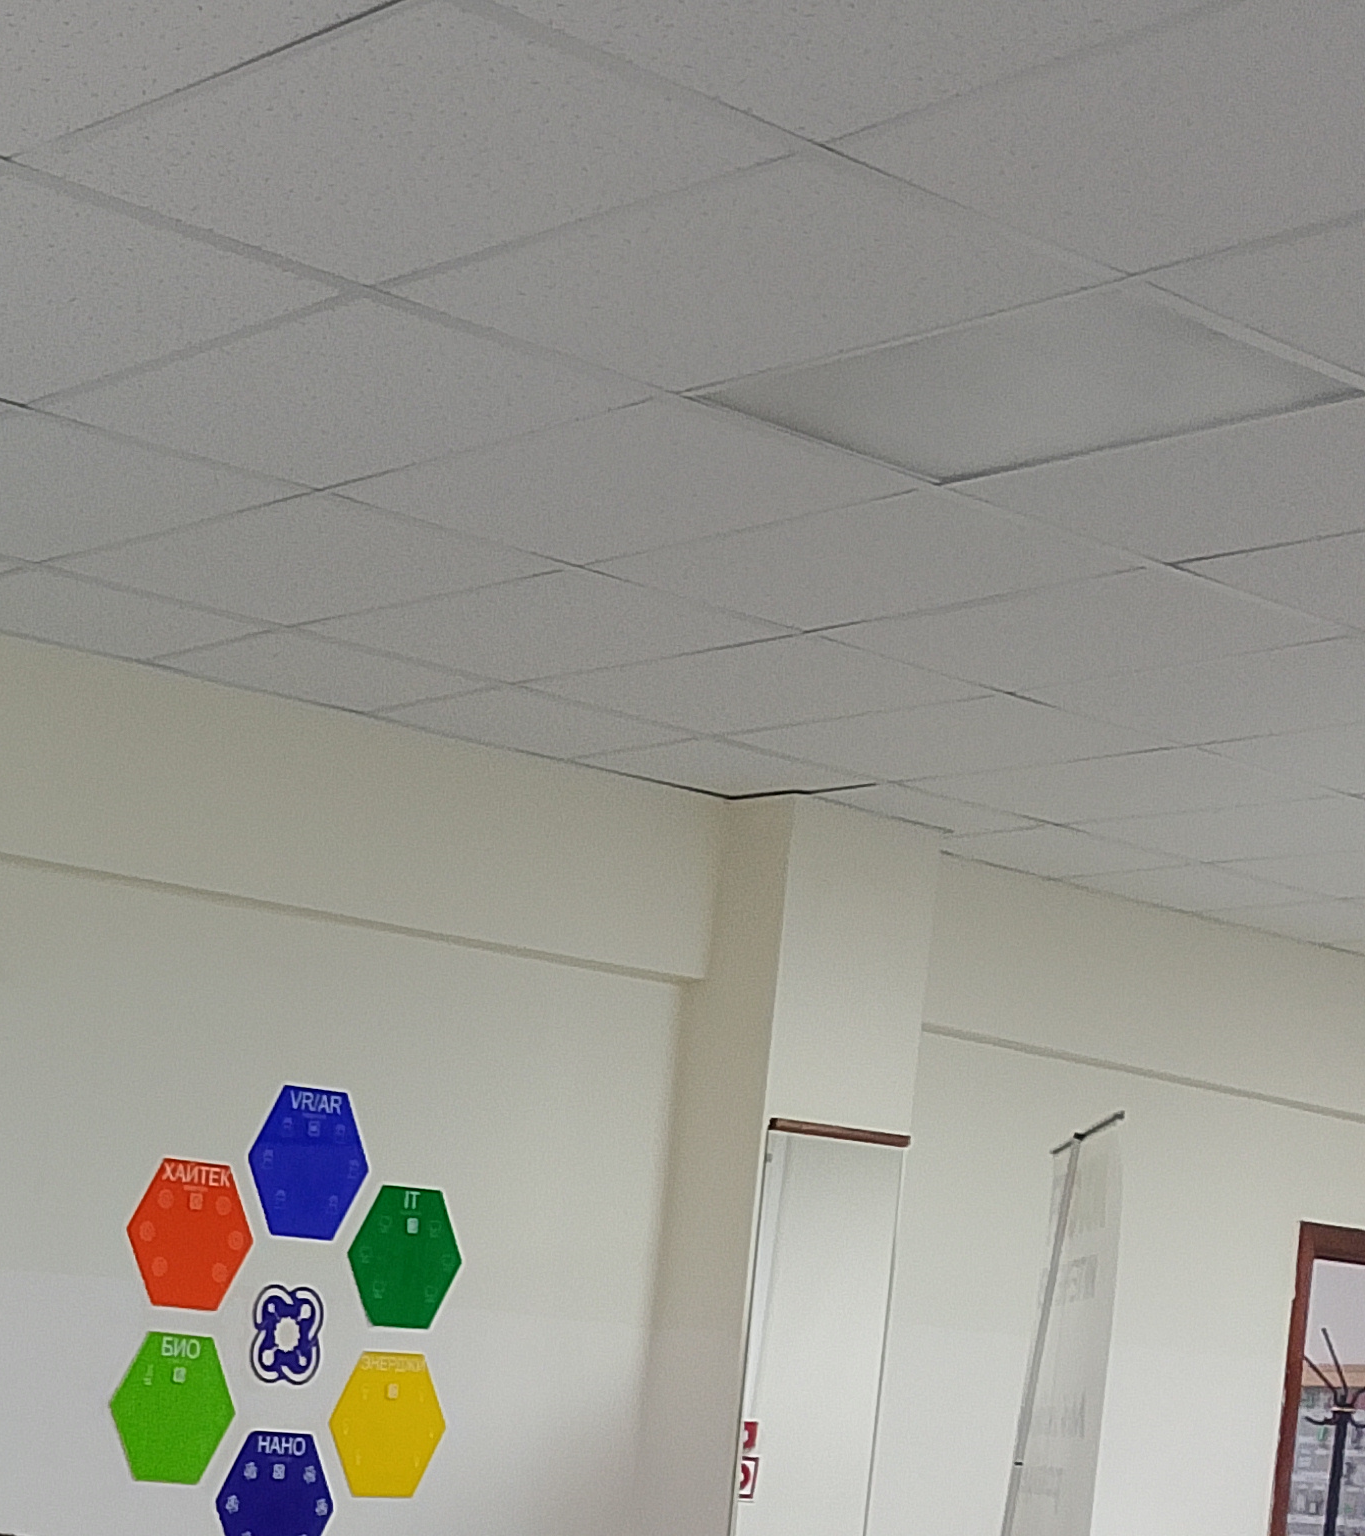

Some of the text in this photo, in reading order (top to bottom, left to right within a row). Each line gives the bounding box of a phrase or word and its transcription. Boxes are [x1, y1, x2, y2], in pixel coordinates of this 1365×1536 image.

[290, 1089, 343, 1115] VR/AR
[161, 1161, 231, 1187] ХАЙТЕК
[403, 1190, 422, 1210] IT
[161, 1336, 201, 1359] БИО
[257, 1435, 307, 1456] НАНО
